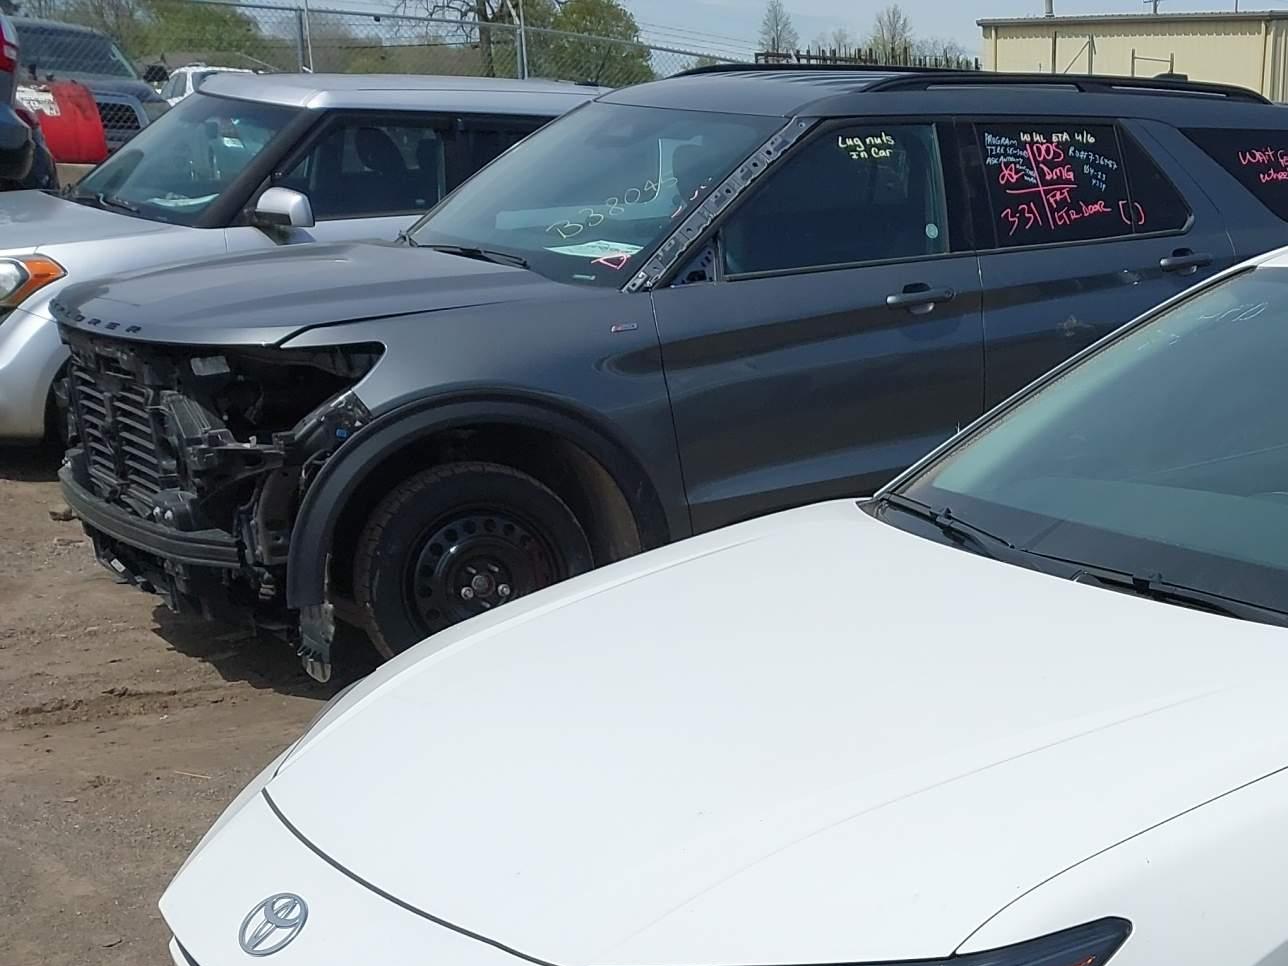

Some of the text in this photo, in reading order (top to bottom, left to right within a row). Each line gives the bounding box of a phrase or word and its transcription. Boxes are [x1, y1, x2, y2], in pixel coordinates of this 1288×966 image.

[838, 135, 865, 151] Lug
[1074, 130, 1096, 144] 4/6
[871, 147, 893, 158] Car
